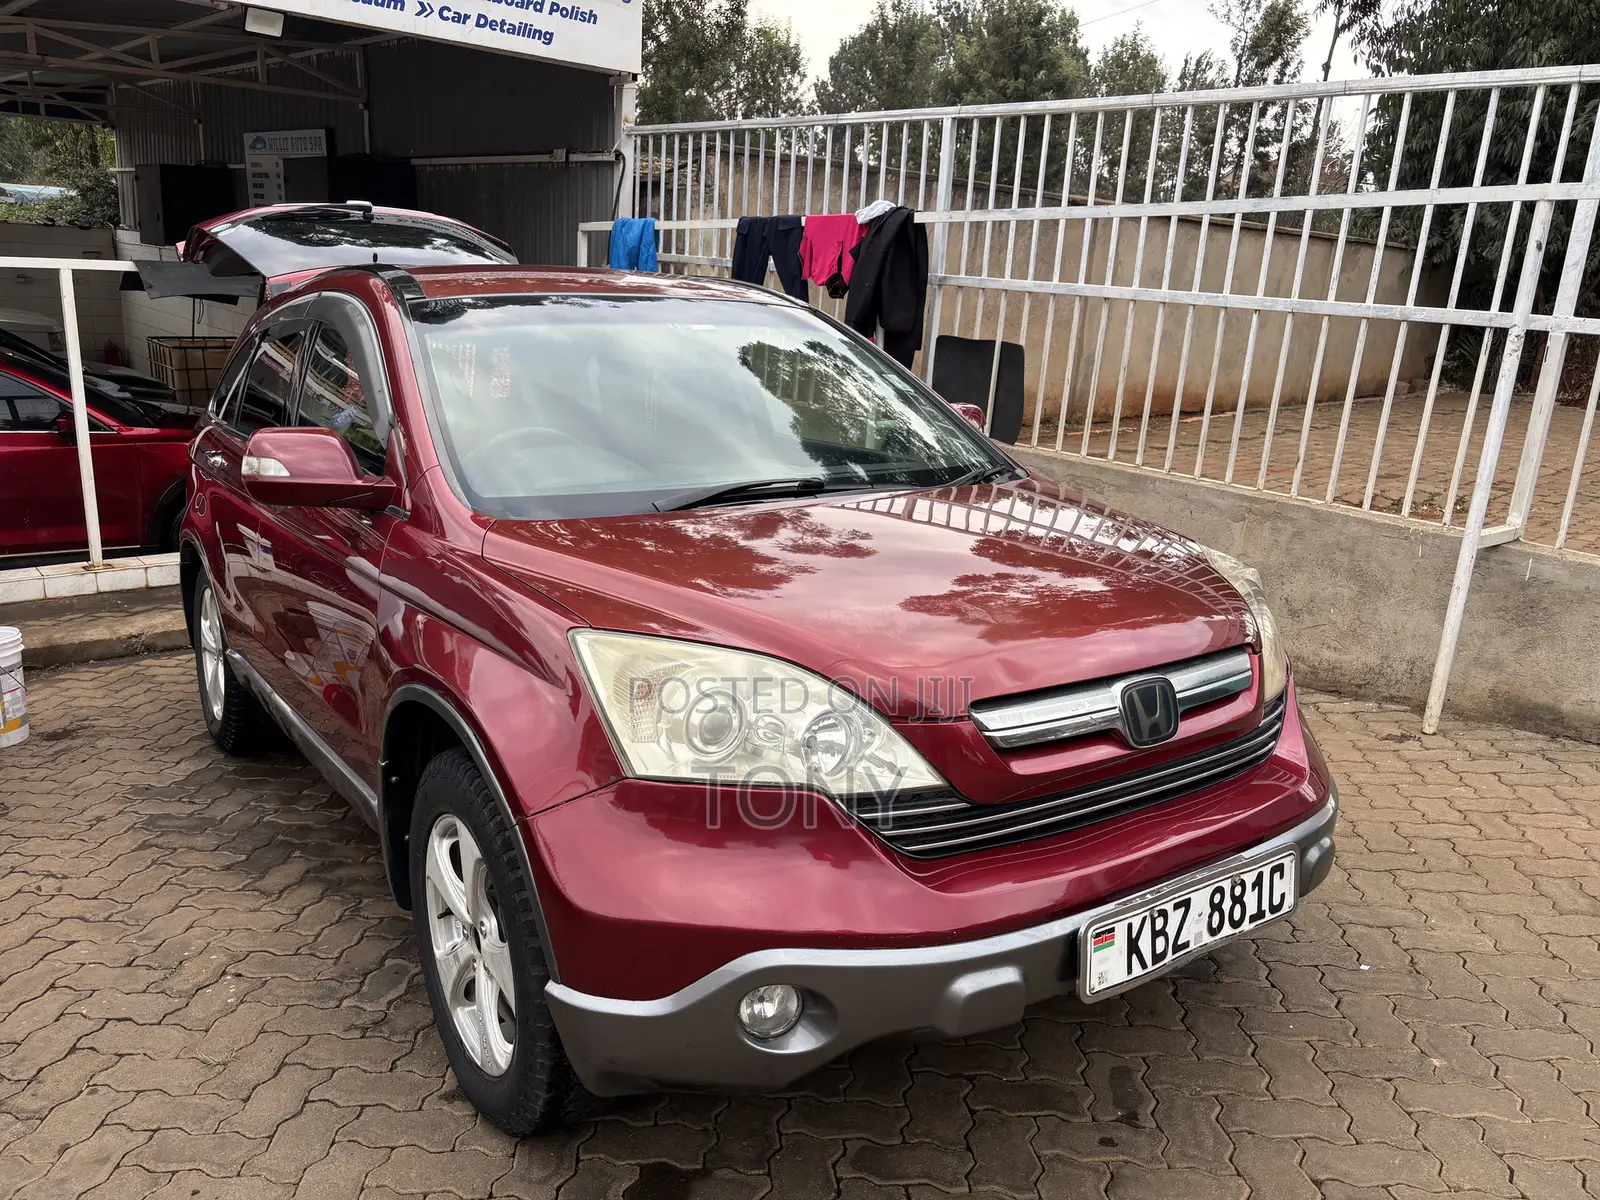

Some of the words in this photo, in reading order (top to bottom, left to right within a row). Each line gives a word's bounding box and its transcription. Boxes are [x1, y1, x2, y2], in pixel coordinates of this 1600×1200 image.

[438, 6, 471, 25] Car
[475, 13, 555, 45] Detailing
[487, 0, 544, 13] oard
[548, 2, 598, 25] Polish
[290, 136, 308, 151] AUTO
[309, 136, 323, 151] SPA
[1126, 897, 1192, 976] KBZ
[1207, 862, 1286, 937] 881C
